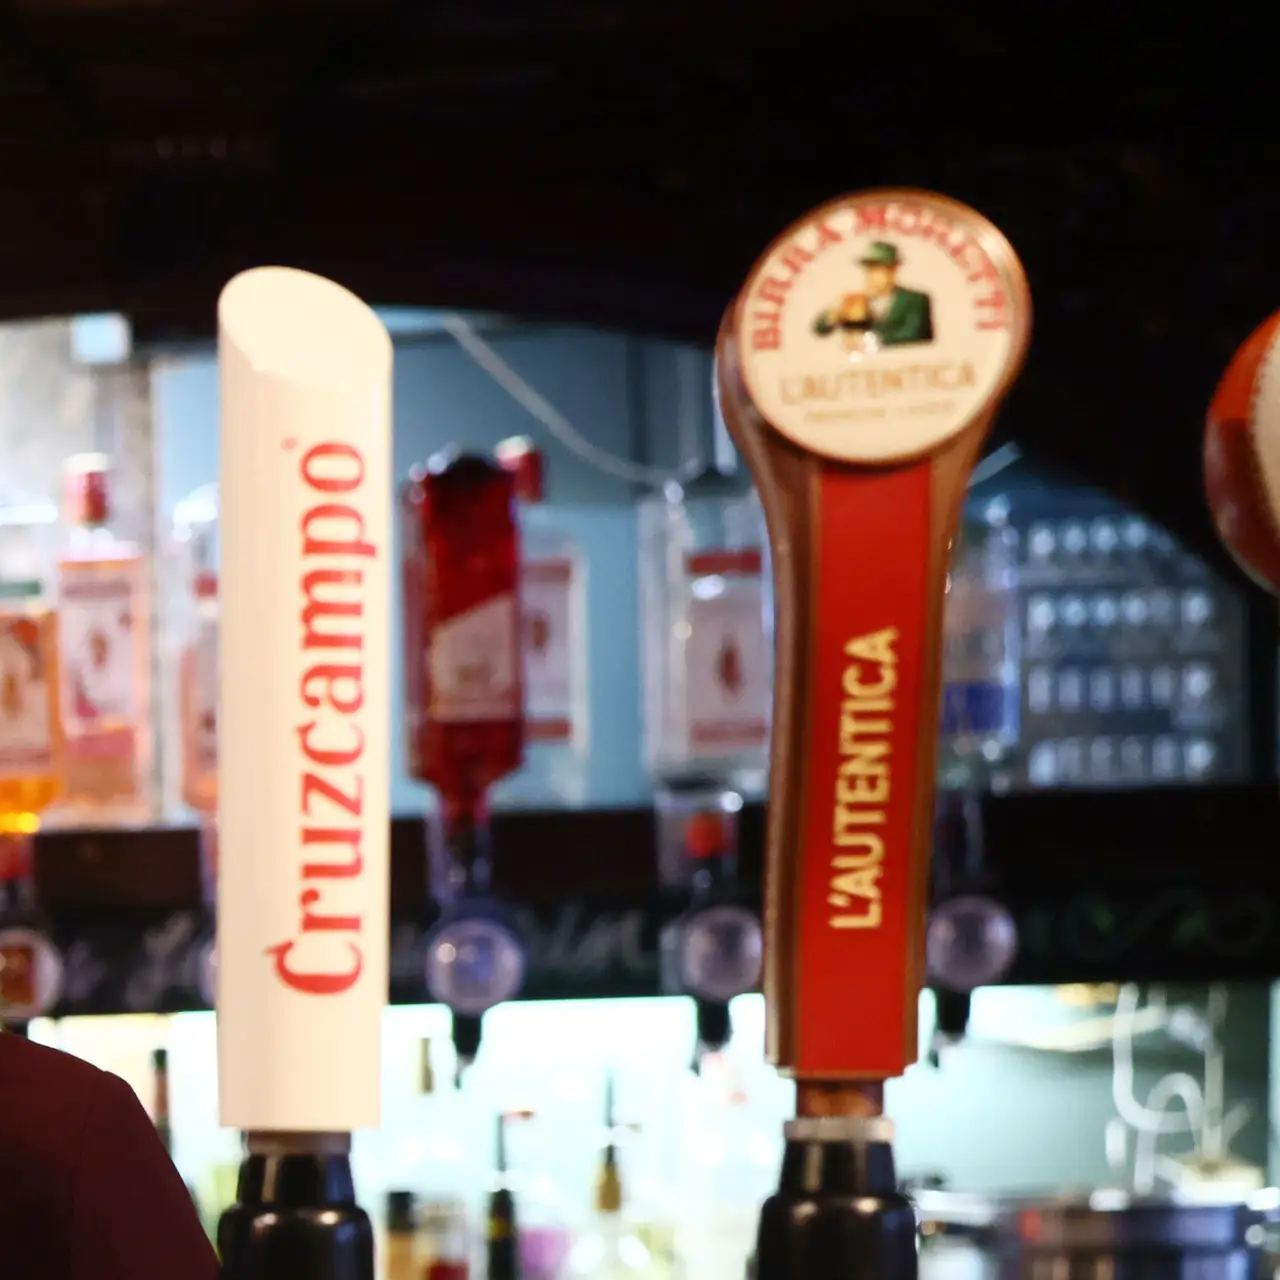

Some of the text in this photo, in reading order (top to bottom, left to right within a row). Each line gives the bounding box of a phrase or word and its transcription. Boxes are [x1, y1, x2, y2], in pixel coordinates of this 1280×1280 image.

[752, 203, 1009, 351] BIRRA MORETTI
[780, 360, 977, 405] L'AUTENTICA
[262, 440, 377, 996] Cruzcampo
[827, 625, 900, 929] L'AUTENTICA
